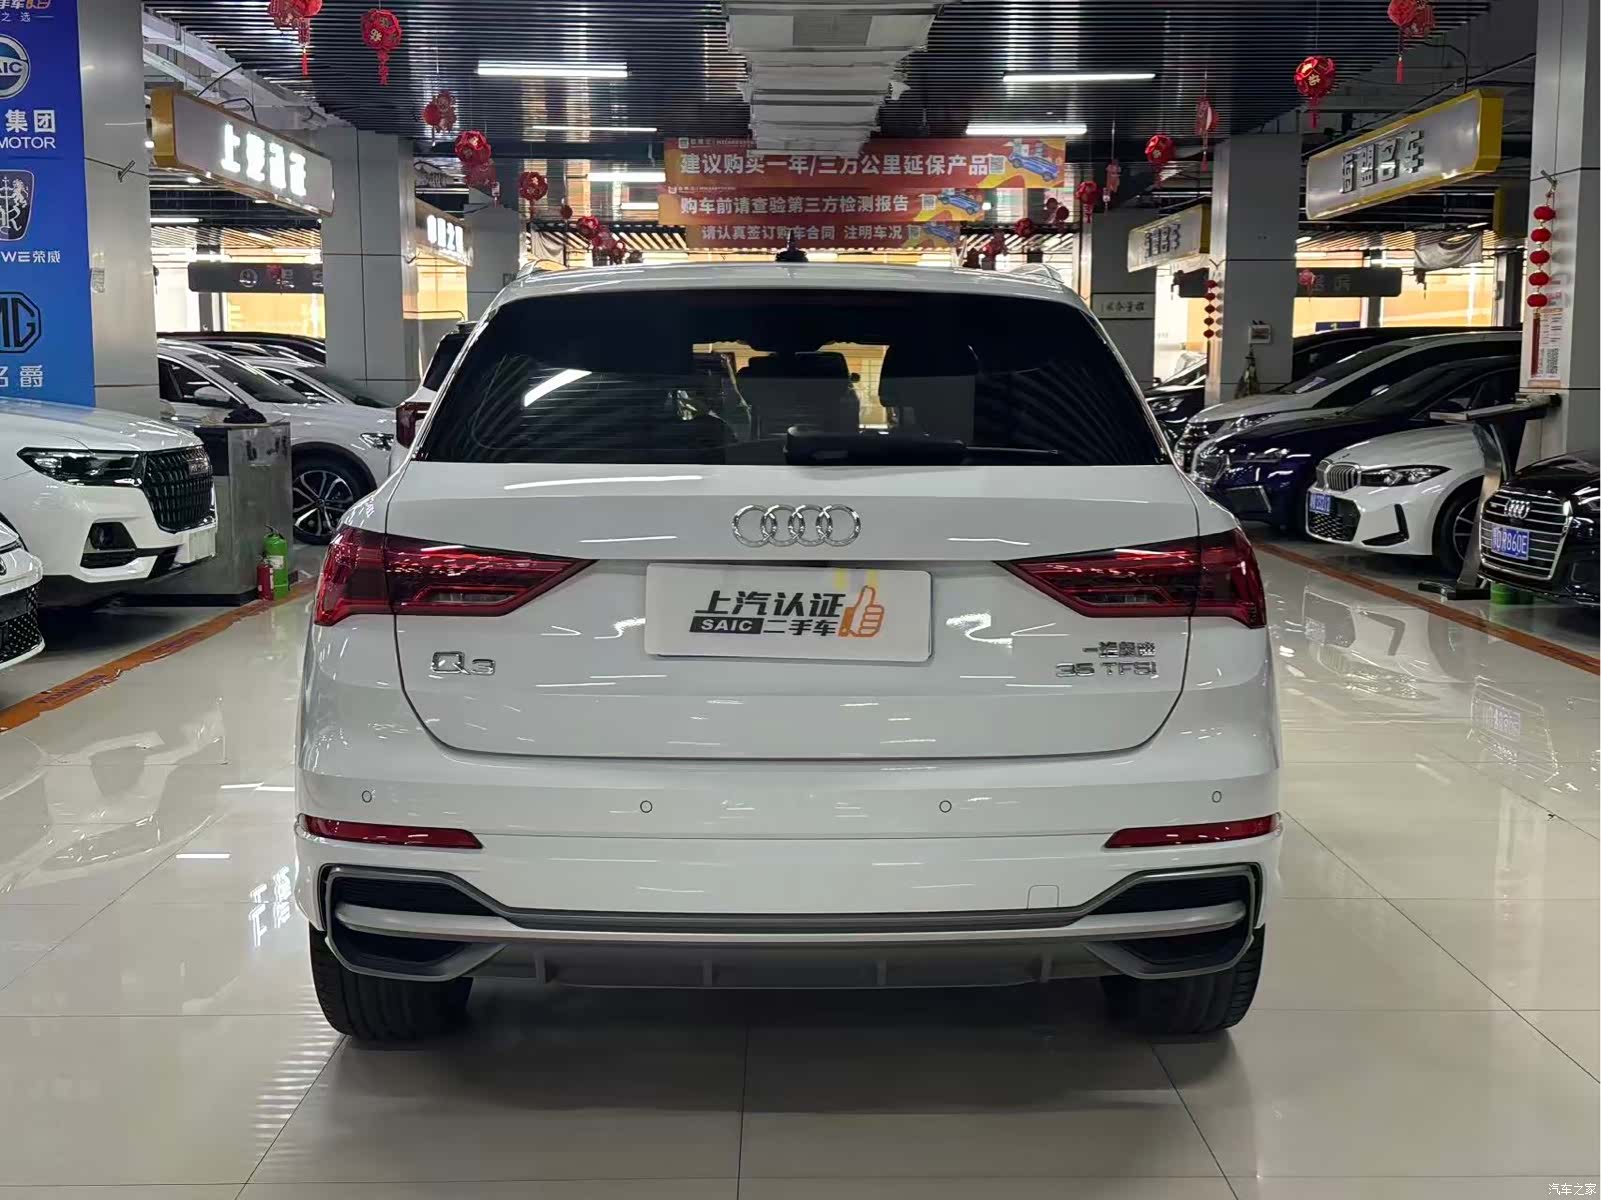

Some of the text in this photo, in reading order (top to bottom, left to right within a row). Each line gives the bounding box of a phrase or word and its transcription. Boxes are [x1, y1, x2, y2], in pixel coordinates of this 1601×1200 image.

[5, 109, 55, 133] 集团
[0, 136, 56, 149] MOTOR
[680, 153, 988, 176] 建议购买一年/三万公里延保产品
[681, 195, 909, 214] 购车前请查验第三方检测报告
[694, 590, 846, 618] 上汽认证
[701, 618, 838, 636] SAIC 二手车
[431, 651, 496, 675] Q3
[1056, 661, 1157, 677] 35 TFSI
